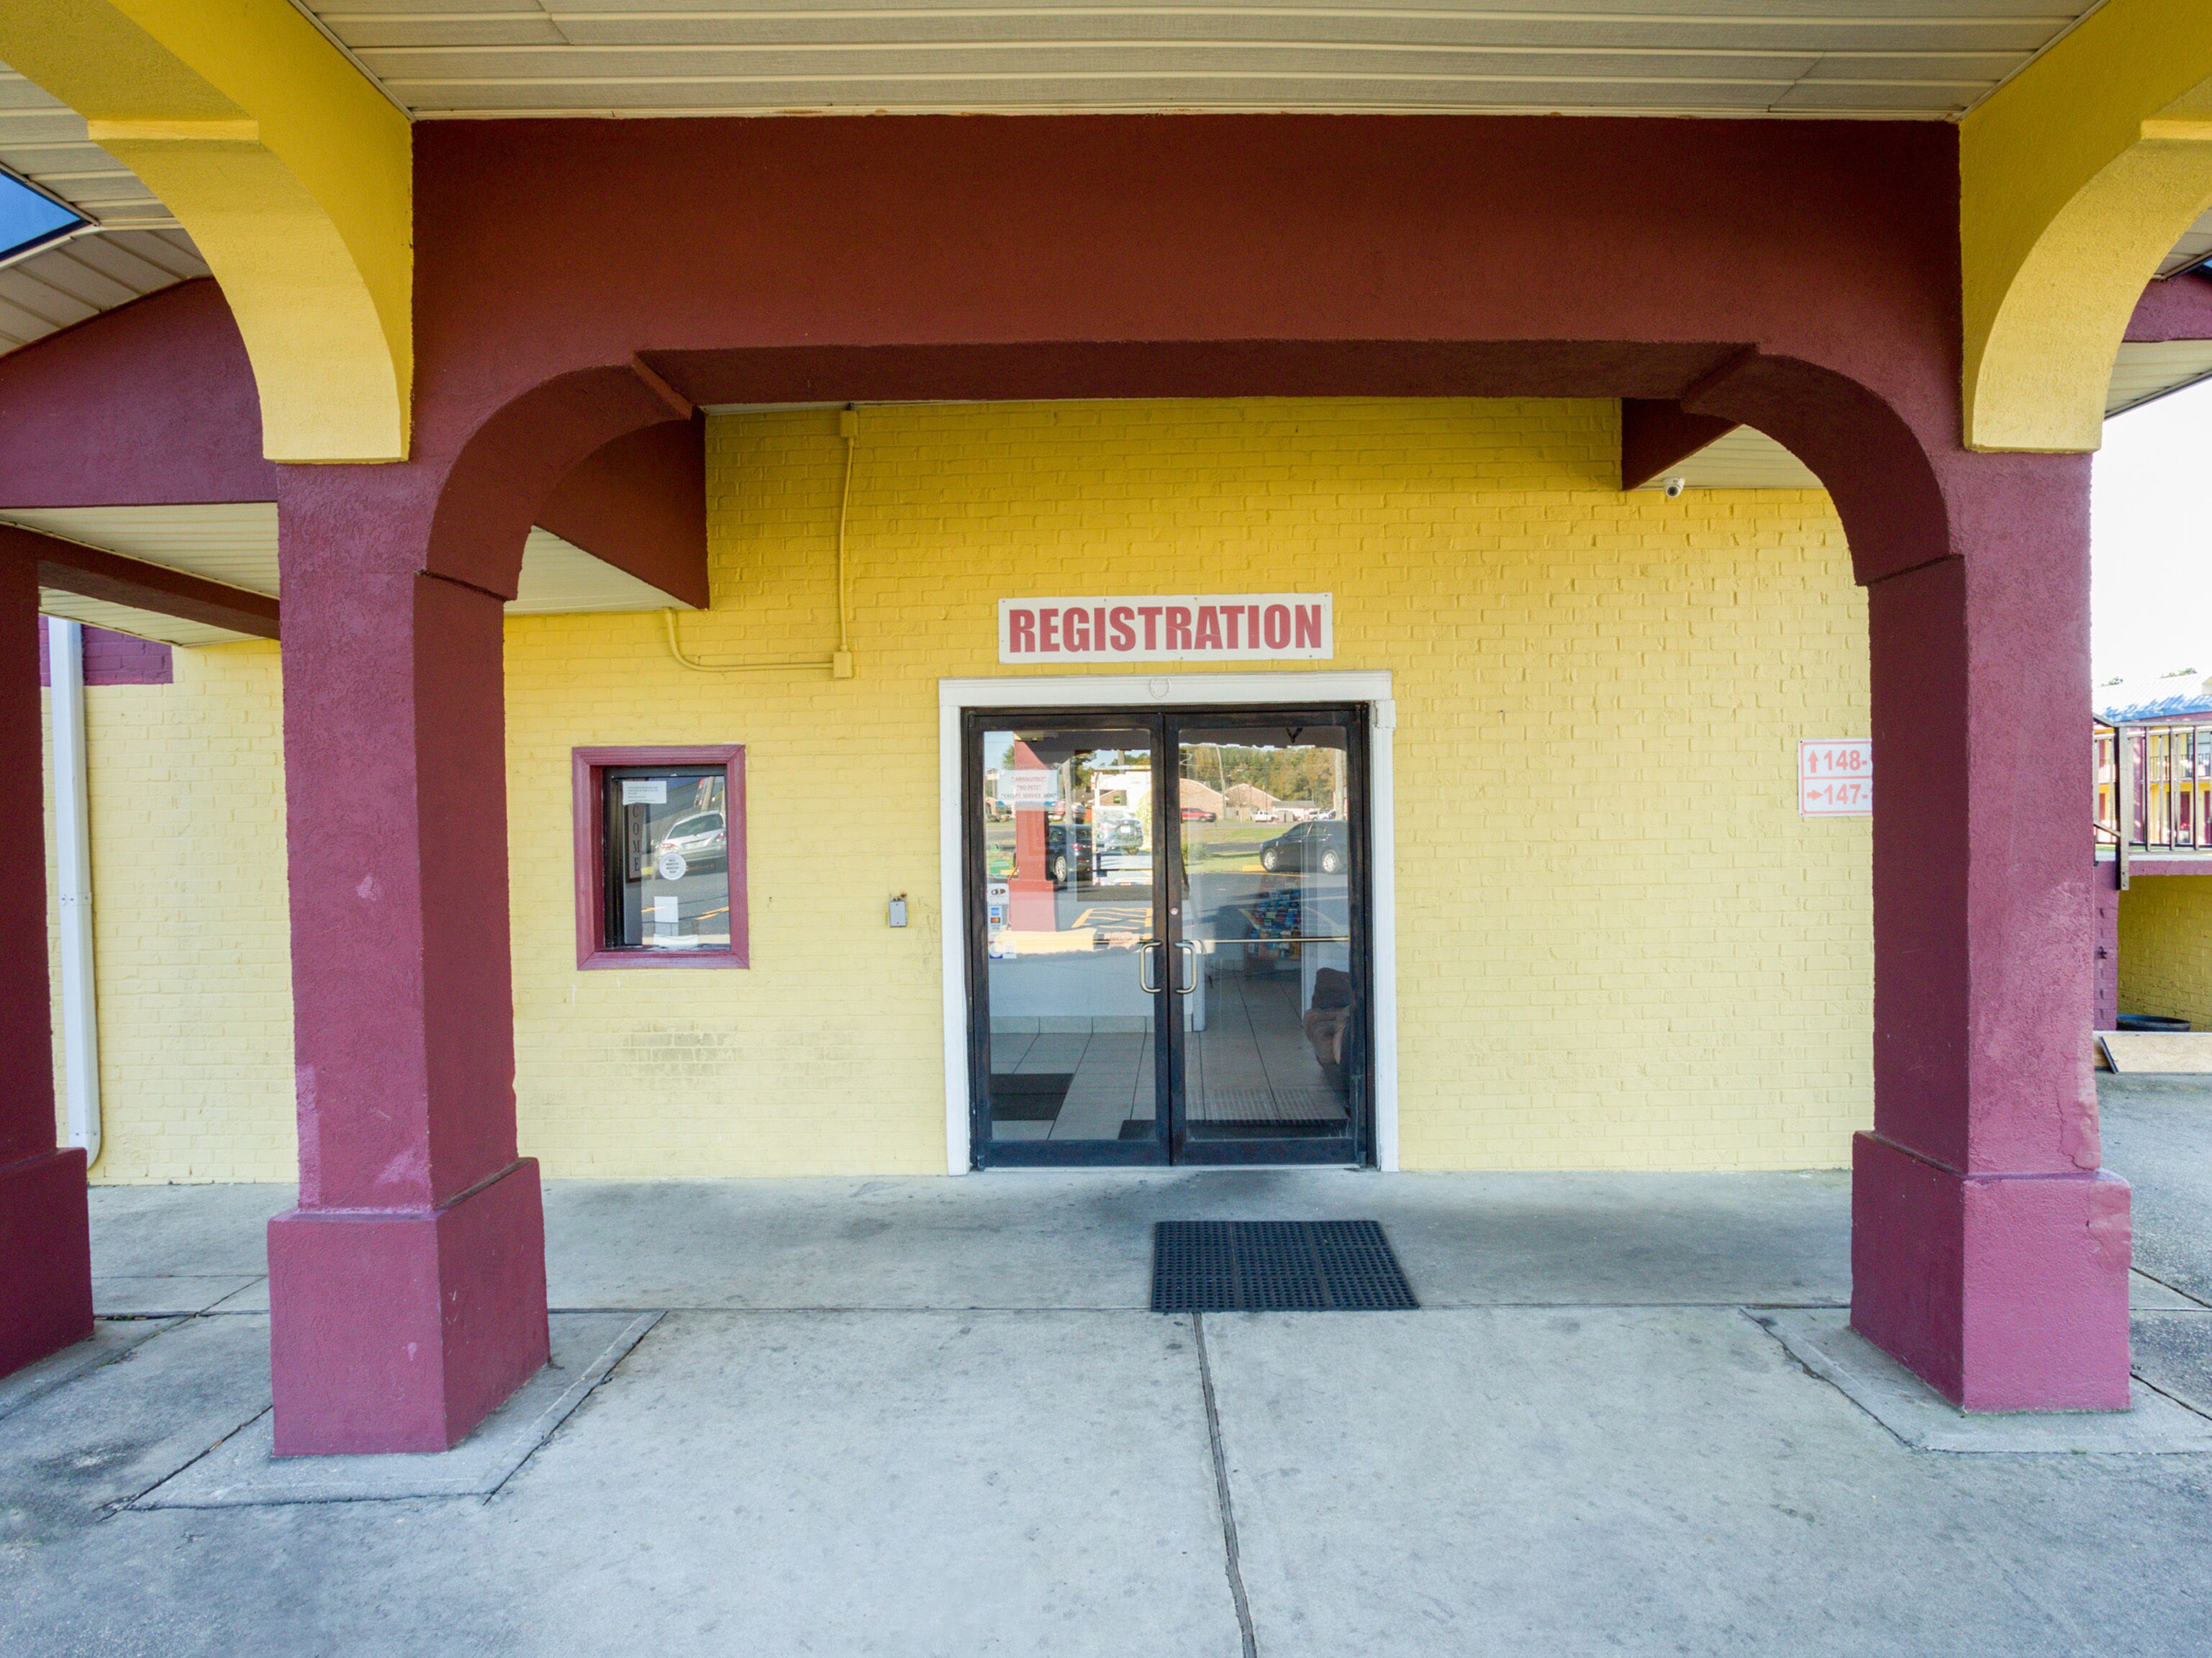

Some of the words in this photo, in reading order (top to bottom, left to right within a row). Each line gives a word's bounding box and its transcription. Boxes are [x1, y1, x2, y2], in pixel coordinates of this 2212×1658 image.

[1009, 604, 1322, 653] REGISTRATION
[1823, 750, 1872, 771] 148-
[1824, 784, 1872, 805] 147-
